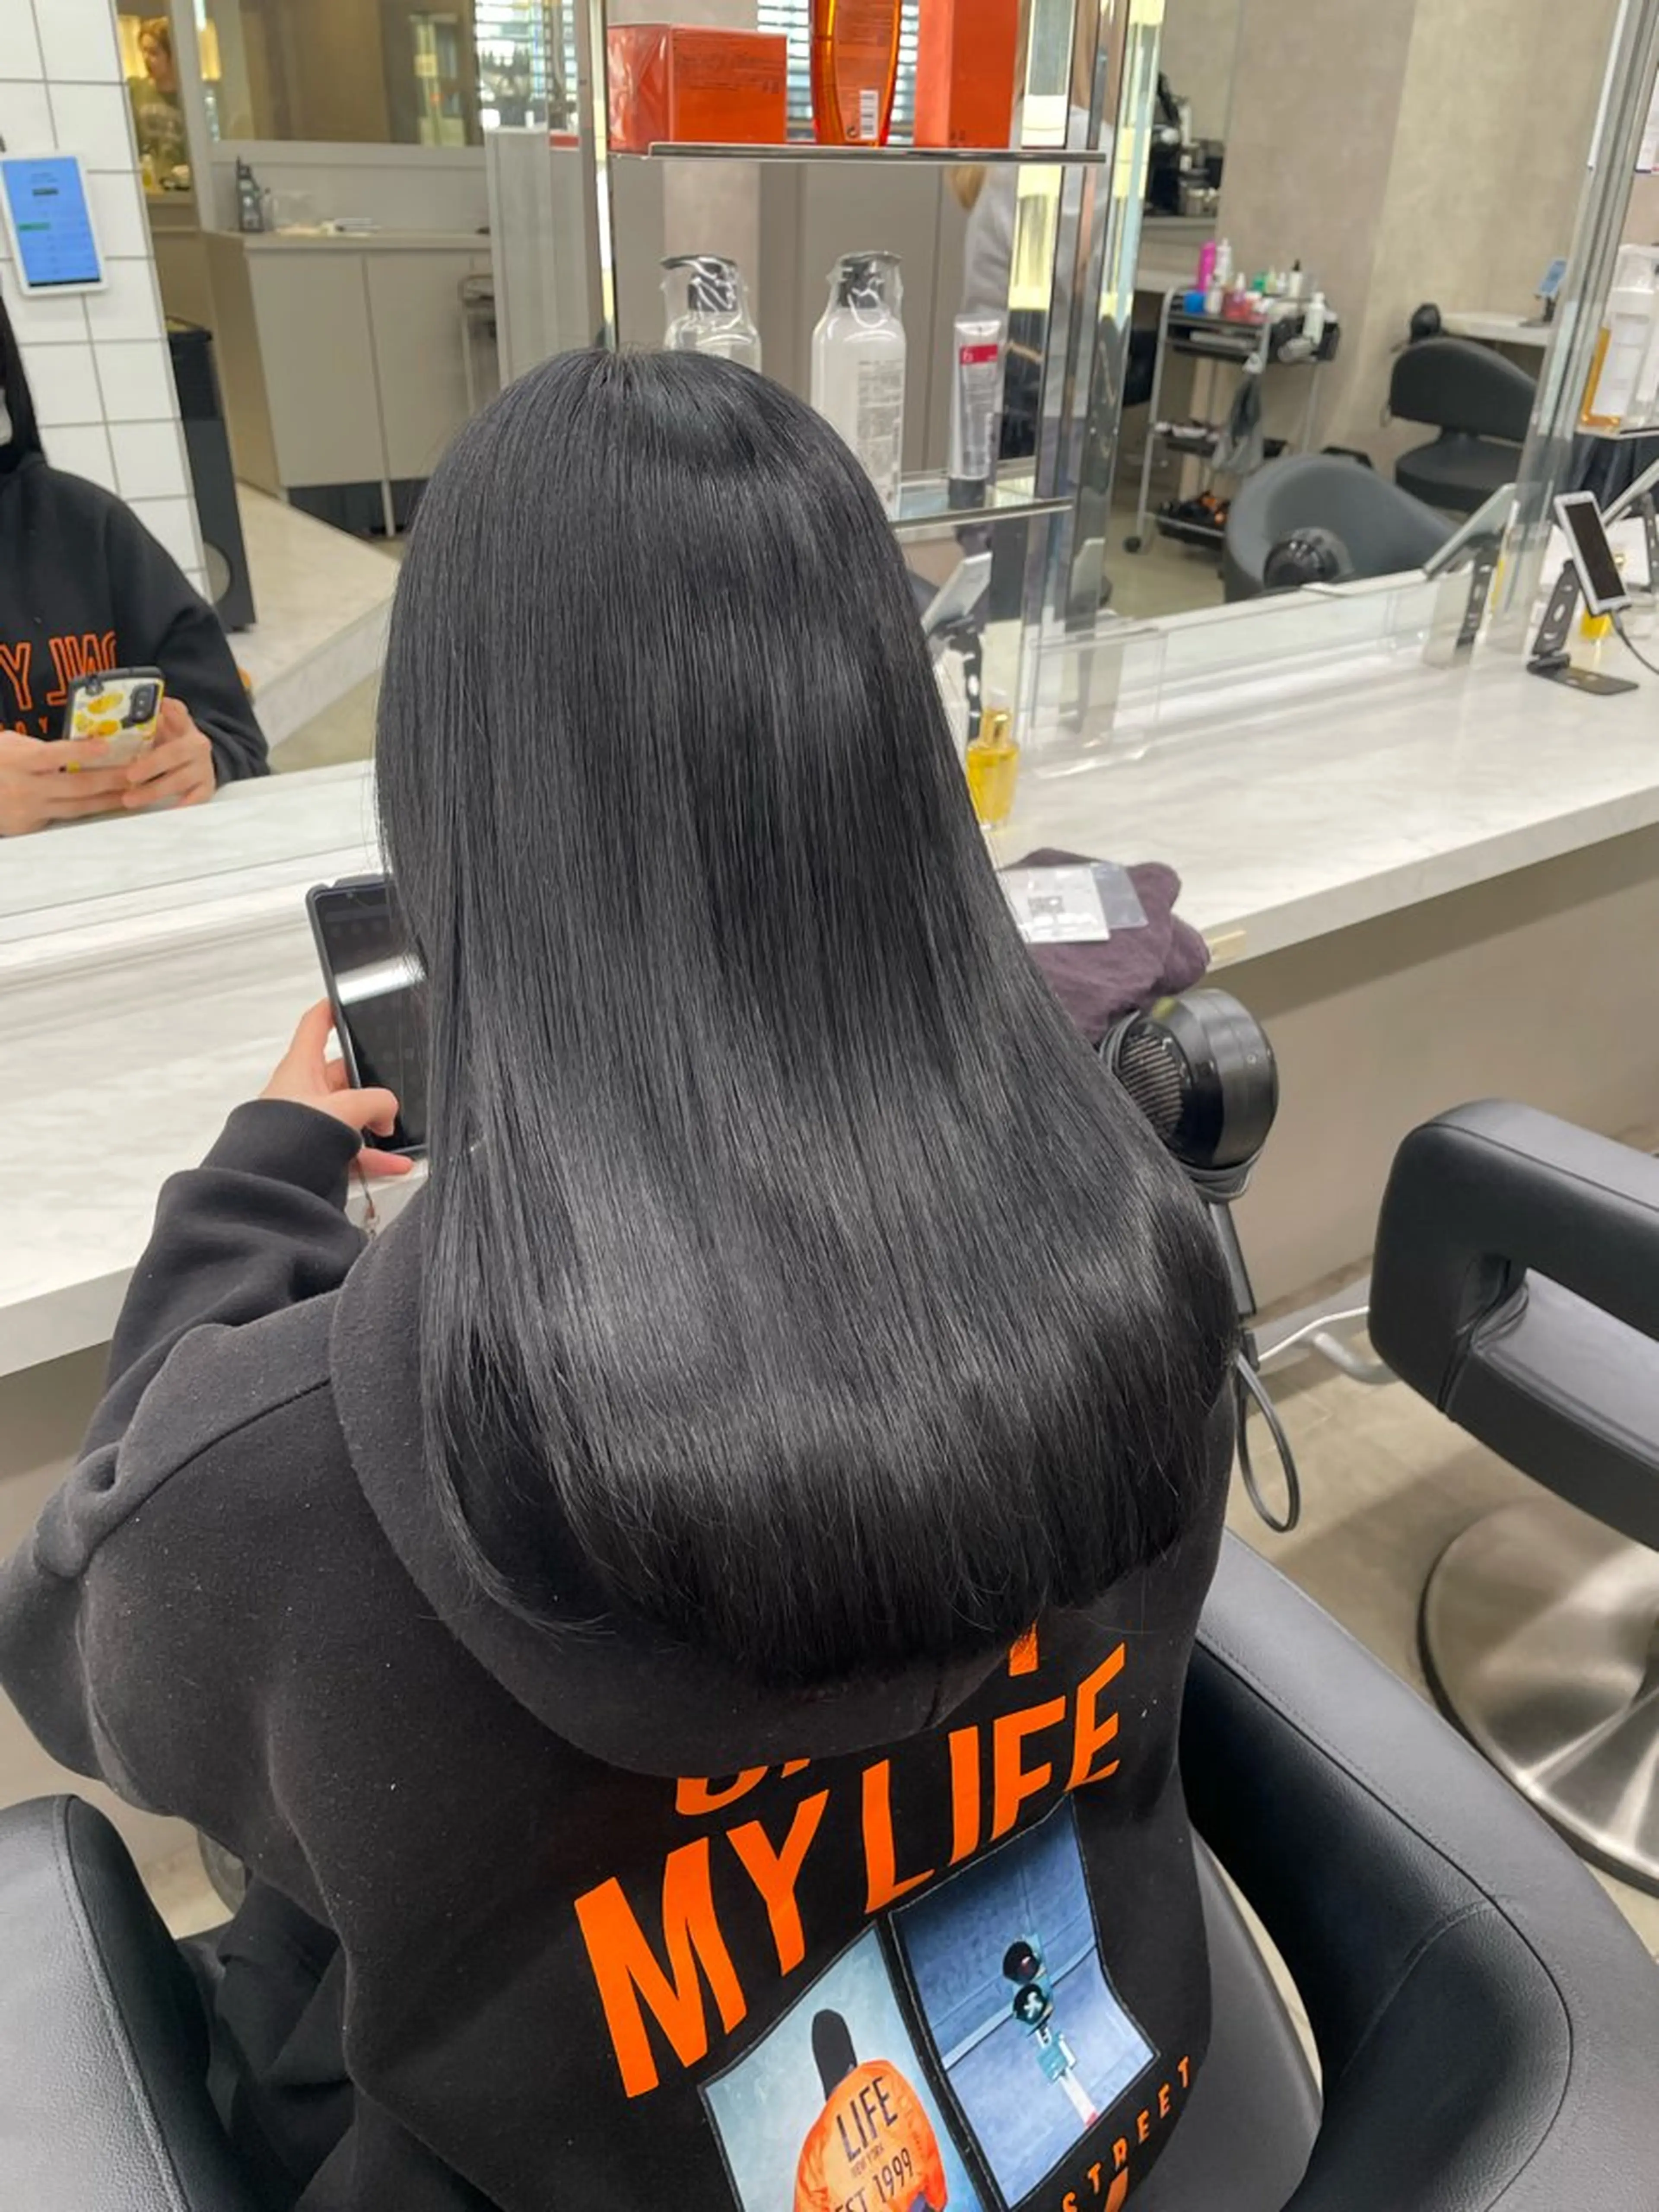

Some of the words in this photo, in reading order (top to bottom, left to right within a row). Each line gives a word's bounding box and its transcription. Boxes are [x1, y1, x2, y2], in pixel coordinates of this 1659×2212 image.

[574, 1789, 829, 2098] MY
[862, 1642, 1125, 1913] LIFE
[836, 2076, 898, 2163] LIFE
[872, 2147, 913, 2203] 1999
